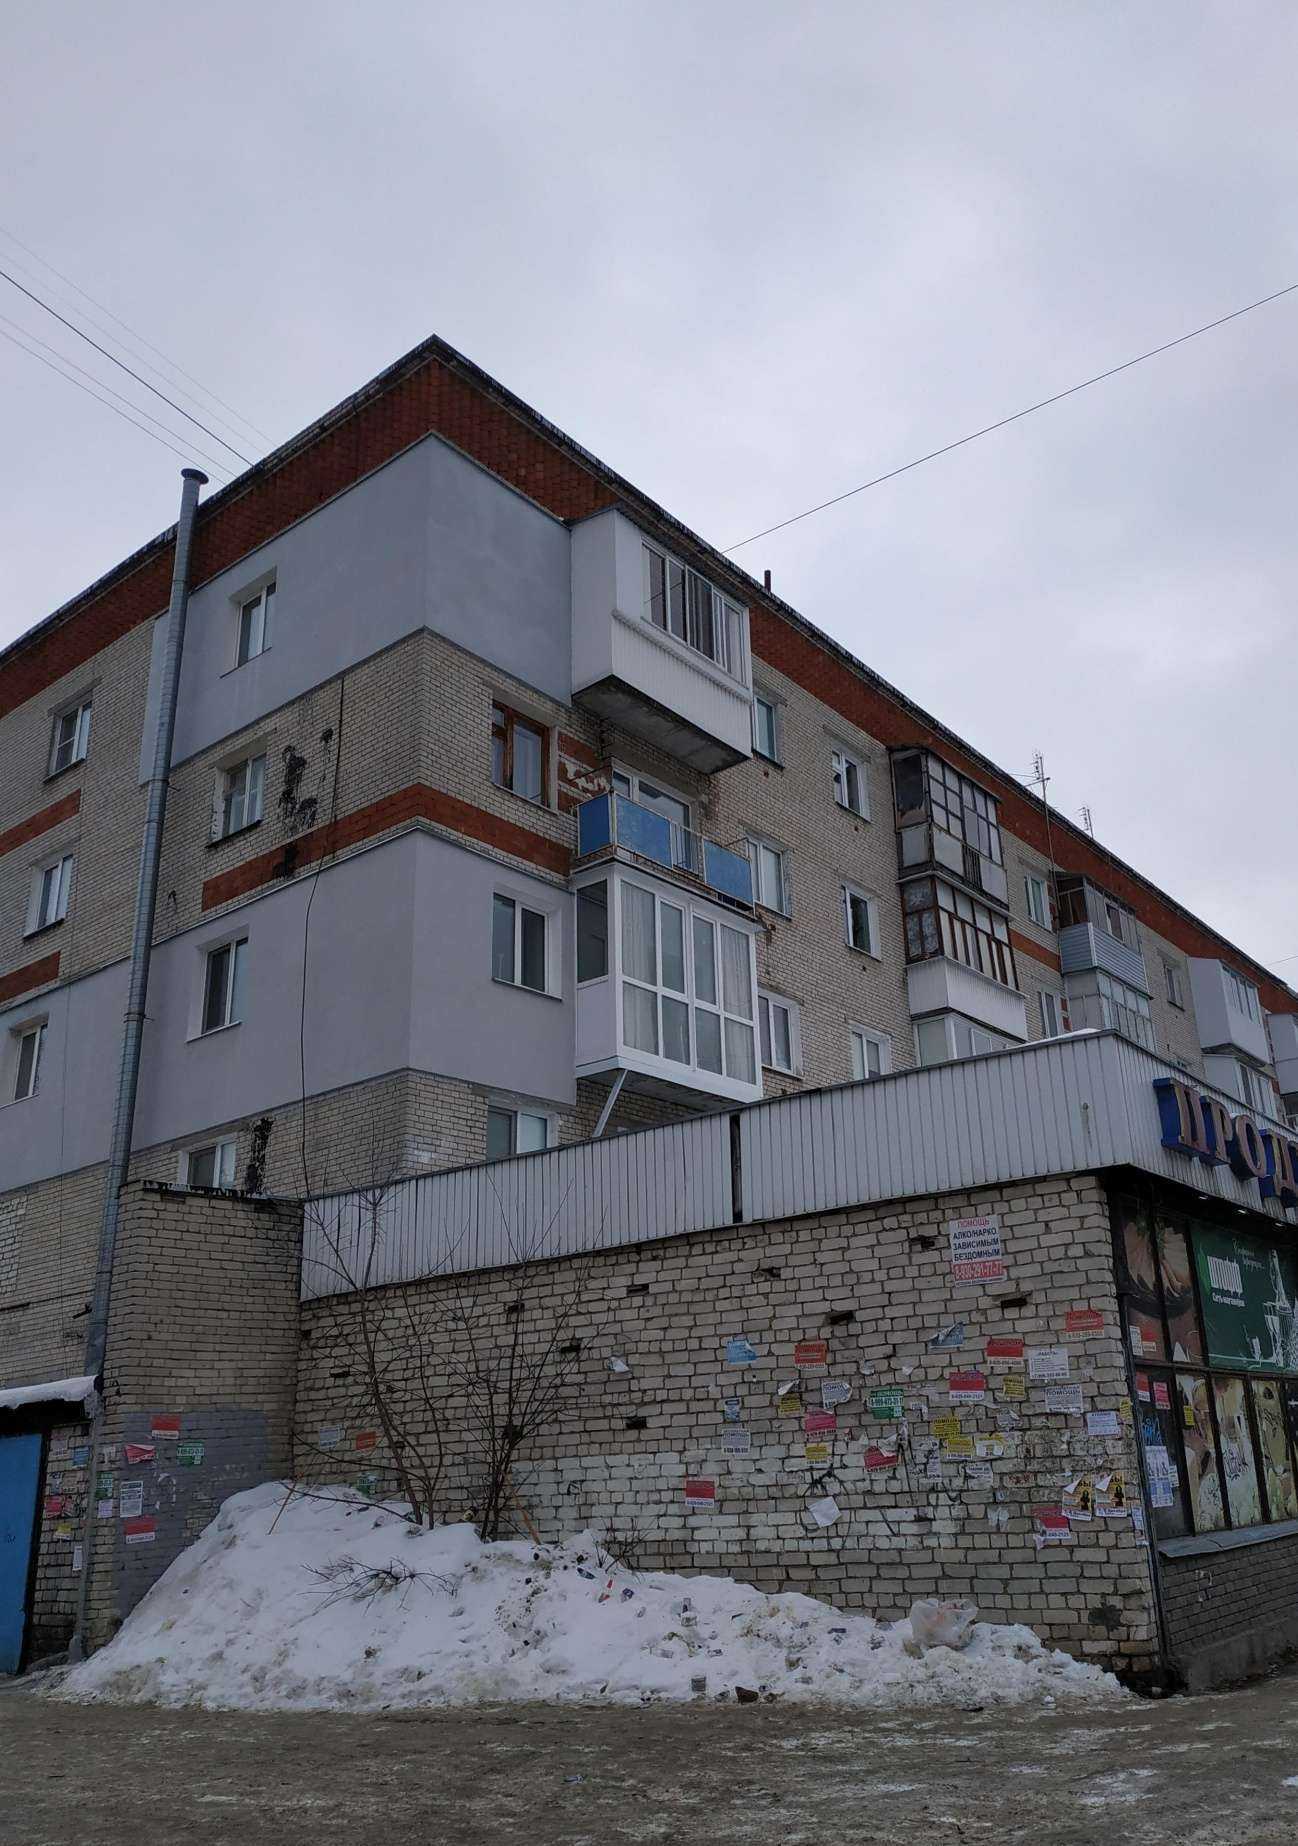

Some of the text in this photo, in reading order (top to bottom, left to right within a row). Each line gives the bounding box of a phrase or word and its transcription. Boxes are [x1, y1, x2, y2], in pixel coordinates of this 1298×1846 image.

[1153, 1077, 1298, 1207] ПРОД
[957, 1217, 990, 1228] ПОМОЩЬ
[953, 1228, 997, 1241] АЛКО/НАРКО
[953, 1238, 999, 1252] ЗАВИСИМЫМ
[954, 1248, 1000, 1262] БЕЗДОМНЫМ
